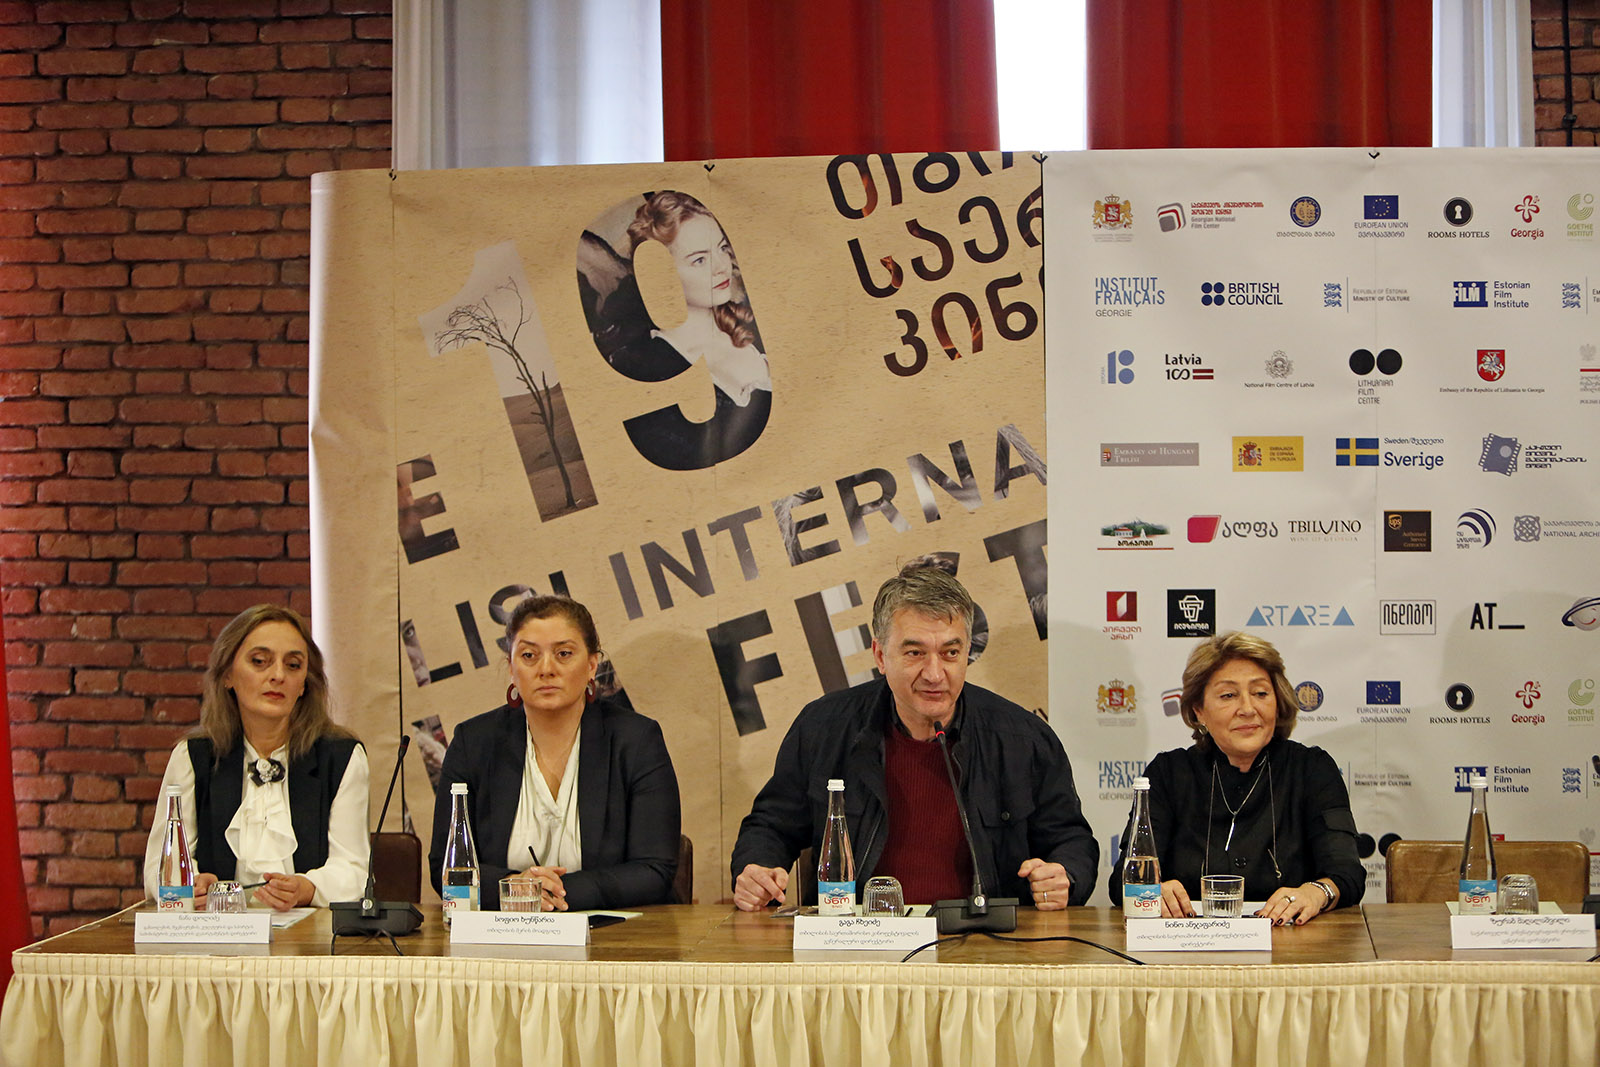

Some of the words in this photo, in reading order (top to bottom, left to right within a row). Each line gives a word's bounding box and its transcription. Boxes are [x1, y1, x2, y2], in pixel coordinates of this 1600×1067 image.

[1511, 228, 1544, 240] Georgia
[1229, 283, 1280, 293] BRITISH
[1494, 281, 1531, 289] Estonian
[1494, 290, 1512, 298] Film
[1228, 294, 1283, 306] COUNCIL
[1494, 300, 1530, 308] Institute
[884, 264, 1044, 377] კინ
[418, 190, 773, 522] 19
[1165, 354, 1202, 365] Latvia
[1384, 451, 1444, 470] Sverige
[1222, 521, 1279, 538] ალფა
[1288, 520, 1362, 534] TBILVINO
[1246, 605, 1355, 626] ARTAREA
[1429, 716, 1458, 724] ROOMS
[1460, 716, 1490, 724] HOTELS
[1511, 713, 1545, 726] Georgia
[1494, 766, 1531, 774] Estonian
[1494, 775, 1512, 783] Film
[1494, 785, 1529, 793] Institute
[824, 897, 850, 905] სნო
[1133, 900, 1159, 908] სნო
[1464, 896, 1491, 904] სნო
